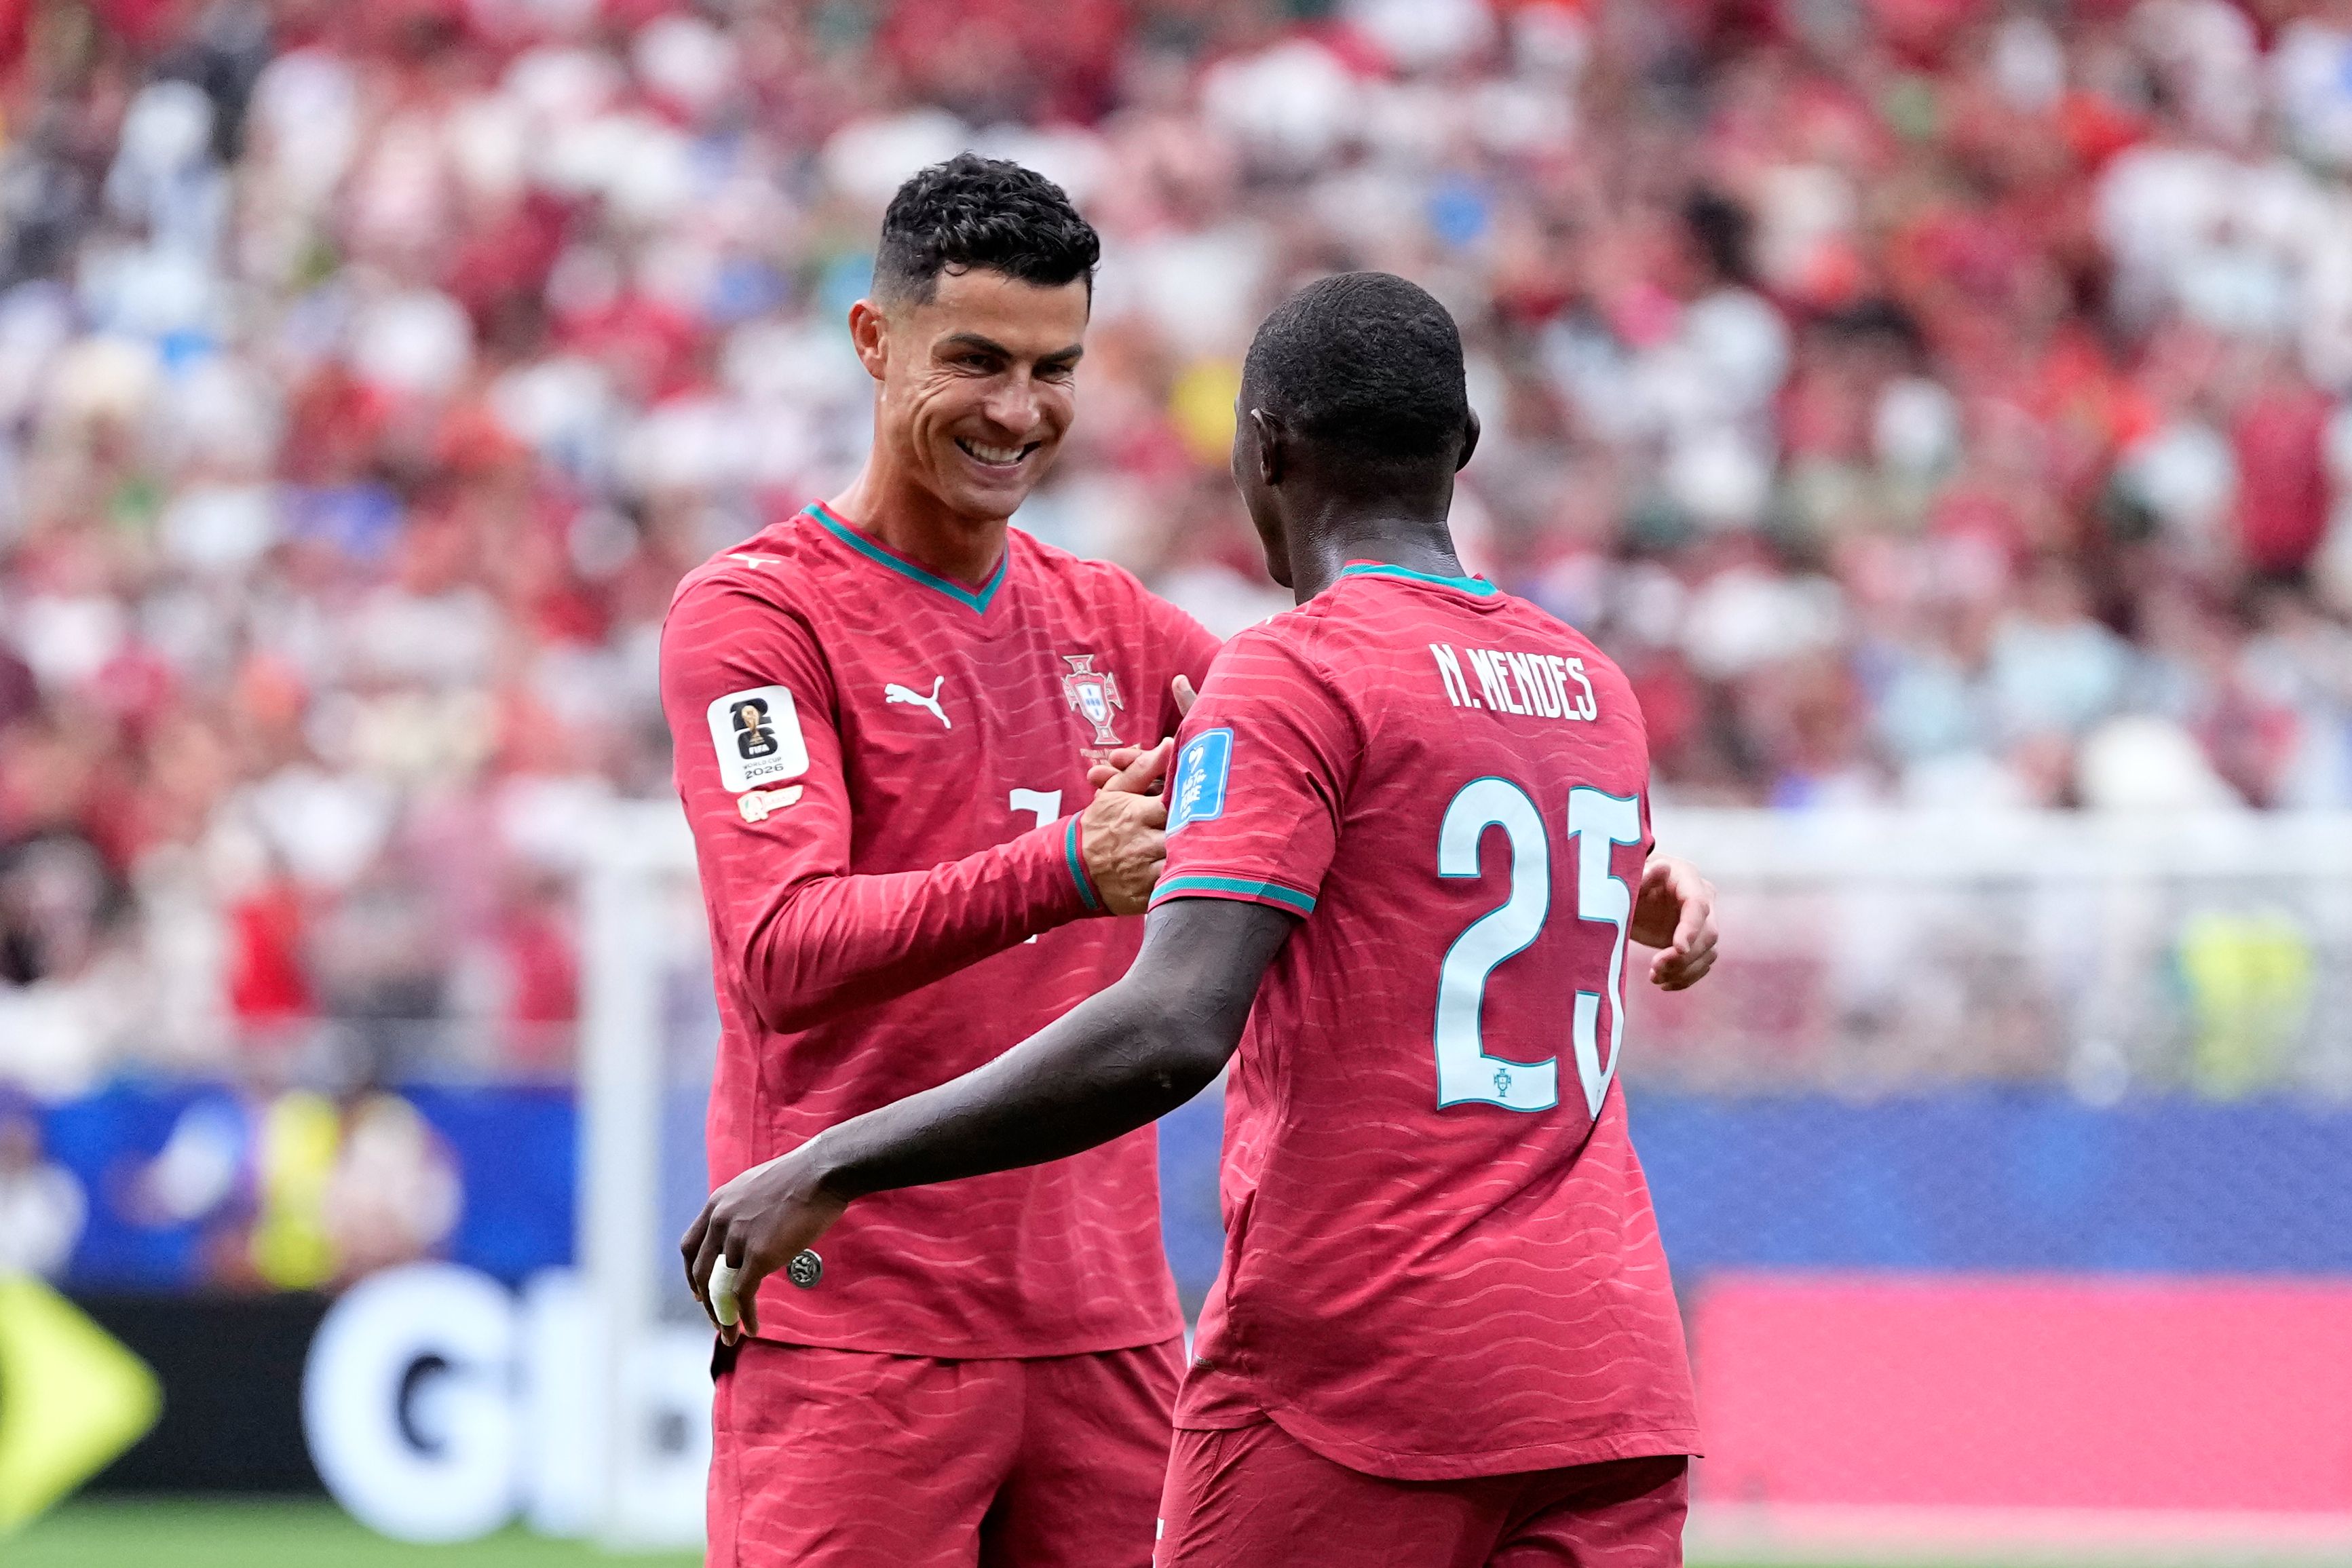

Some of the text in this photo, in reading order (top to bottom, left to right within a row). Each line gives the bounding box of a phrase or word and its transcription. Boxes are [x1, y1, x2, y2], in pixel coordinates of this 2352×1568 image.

[1428, 643, 1597, 721] N.MENDES
[745, 763, 784, 780] 2026
[1433, 775, 1642, 1121] 25
